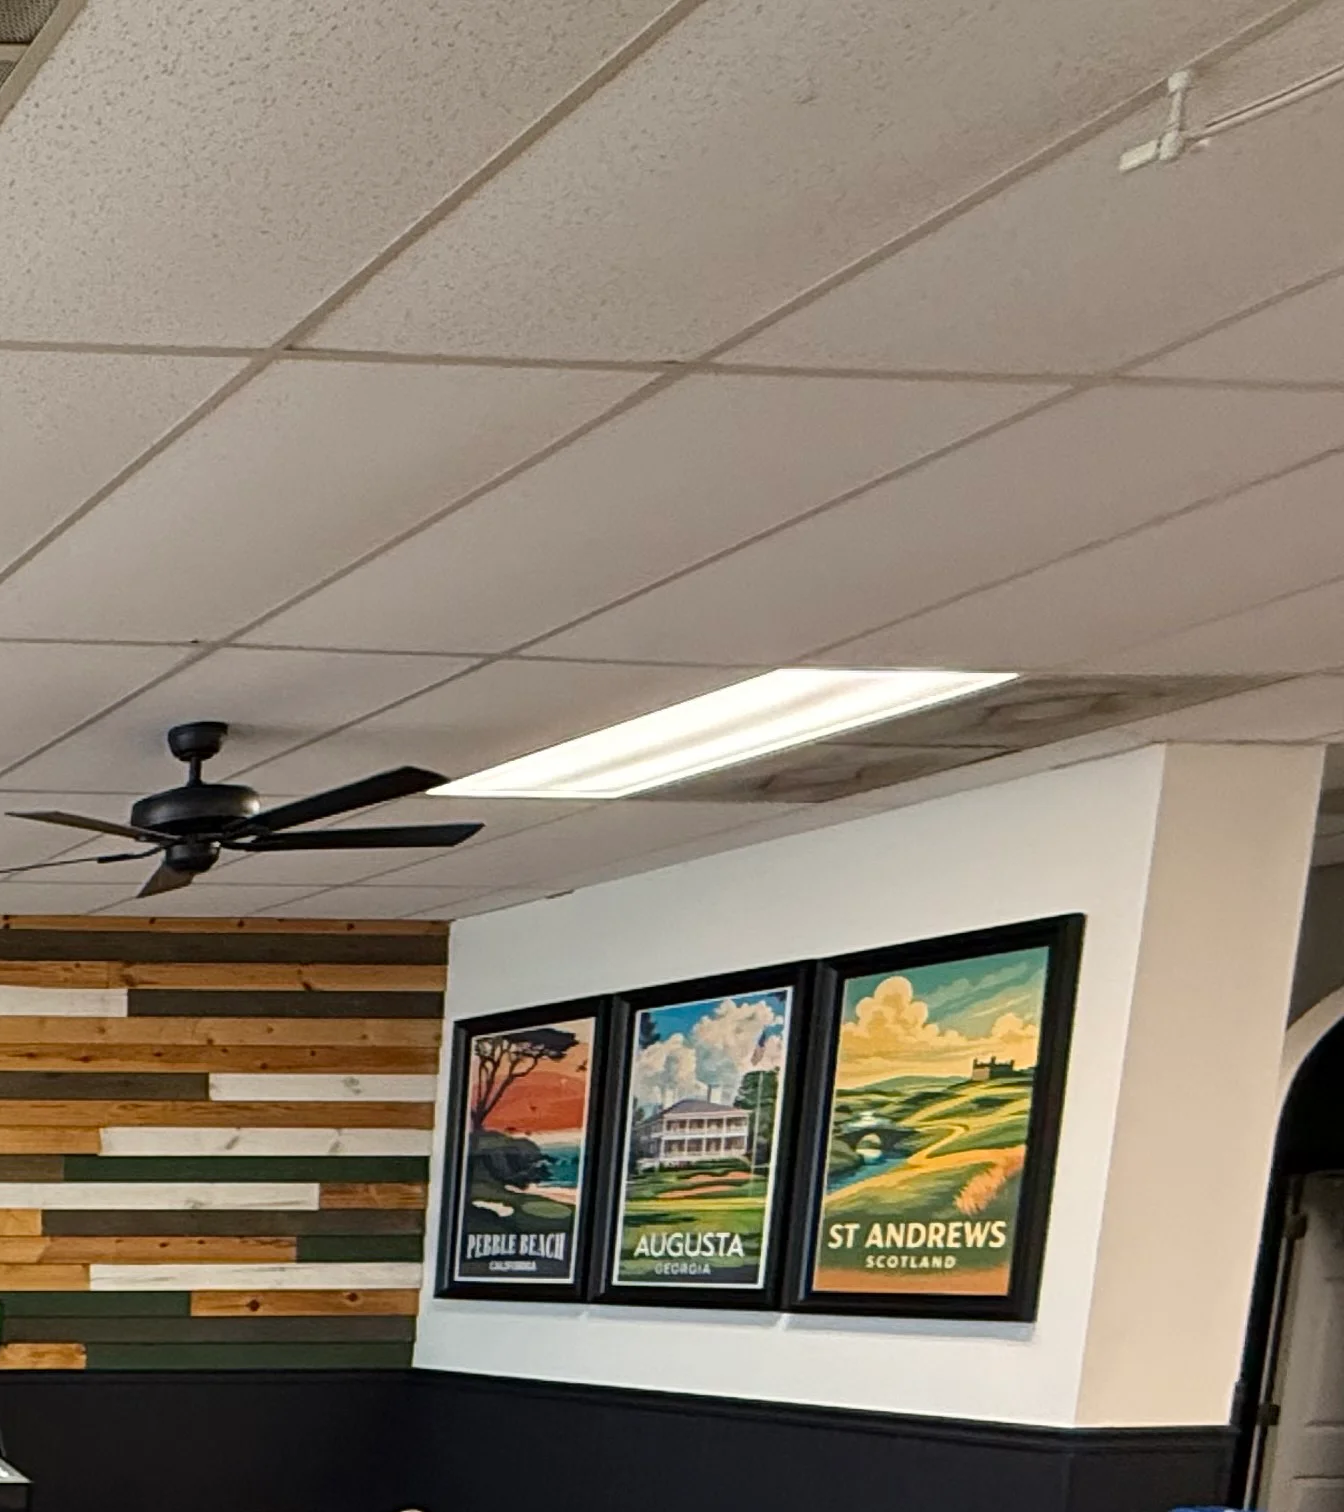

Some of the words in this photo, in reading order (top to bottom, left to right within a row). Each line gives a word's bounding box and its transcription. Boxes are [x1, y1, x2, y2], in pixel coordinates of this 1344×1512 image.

[466, 1233, 517, 1260] PEBBLE
[519, 1232, 567, 1261] BEACH
[633, 1231, 746, 1258] AUGUSTA
[827, 1223, 861, 1250] ST
[864, 1220, 1008, 1249] ANDREWS
[654, 1261, 712, 1275] GEORGIA
[865, 1255, 957, 1269] SCOTLAND
